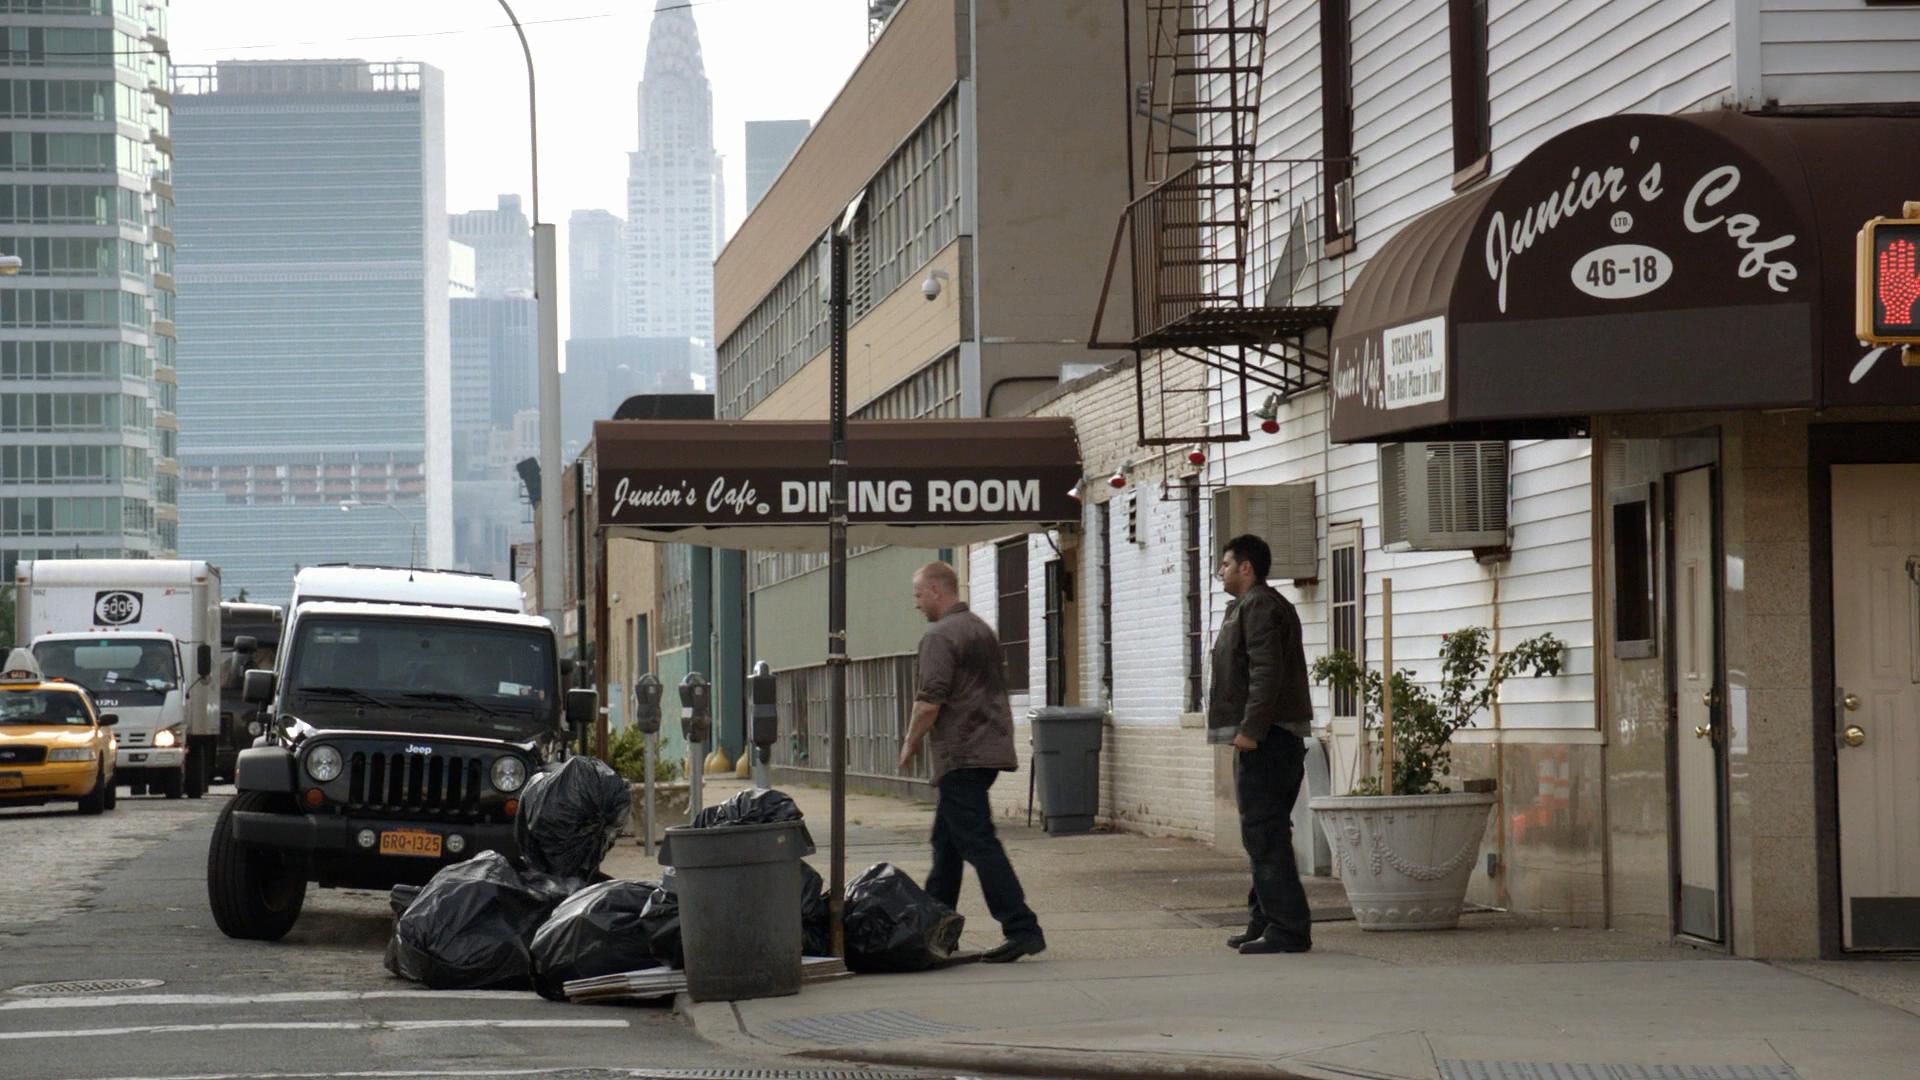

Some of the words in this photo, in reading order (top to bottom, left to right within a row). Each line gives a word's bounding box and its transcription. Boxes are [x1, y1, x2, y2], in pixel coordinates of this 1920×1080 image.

[1485, 136, 1664, 314] Junior's
[1683, 165, 1798, 293] Cafe
[1586, 255, 1658, 287] 46-18
[611, 477, 697, 517] Junior's
[706, 476, 757, 515] Cafe
[928, 479, 1040, 512] ROOM
[103, 598, 134, 616] edge
[405, 744, 432, 756] Jeep
